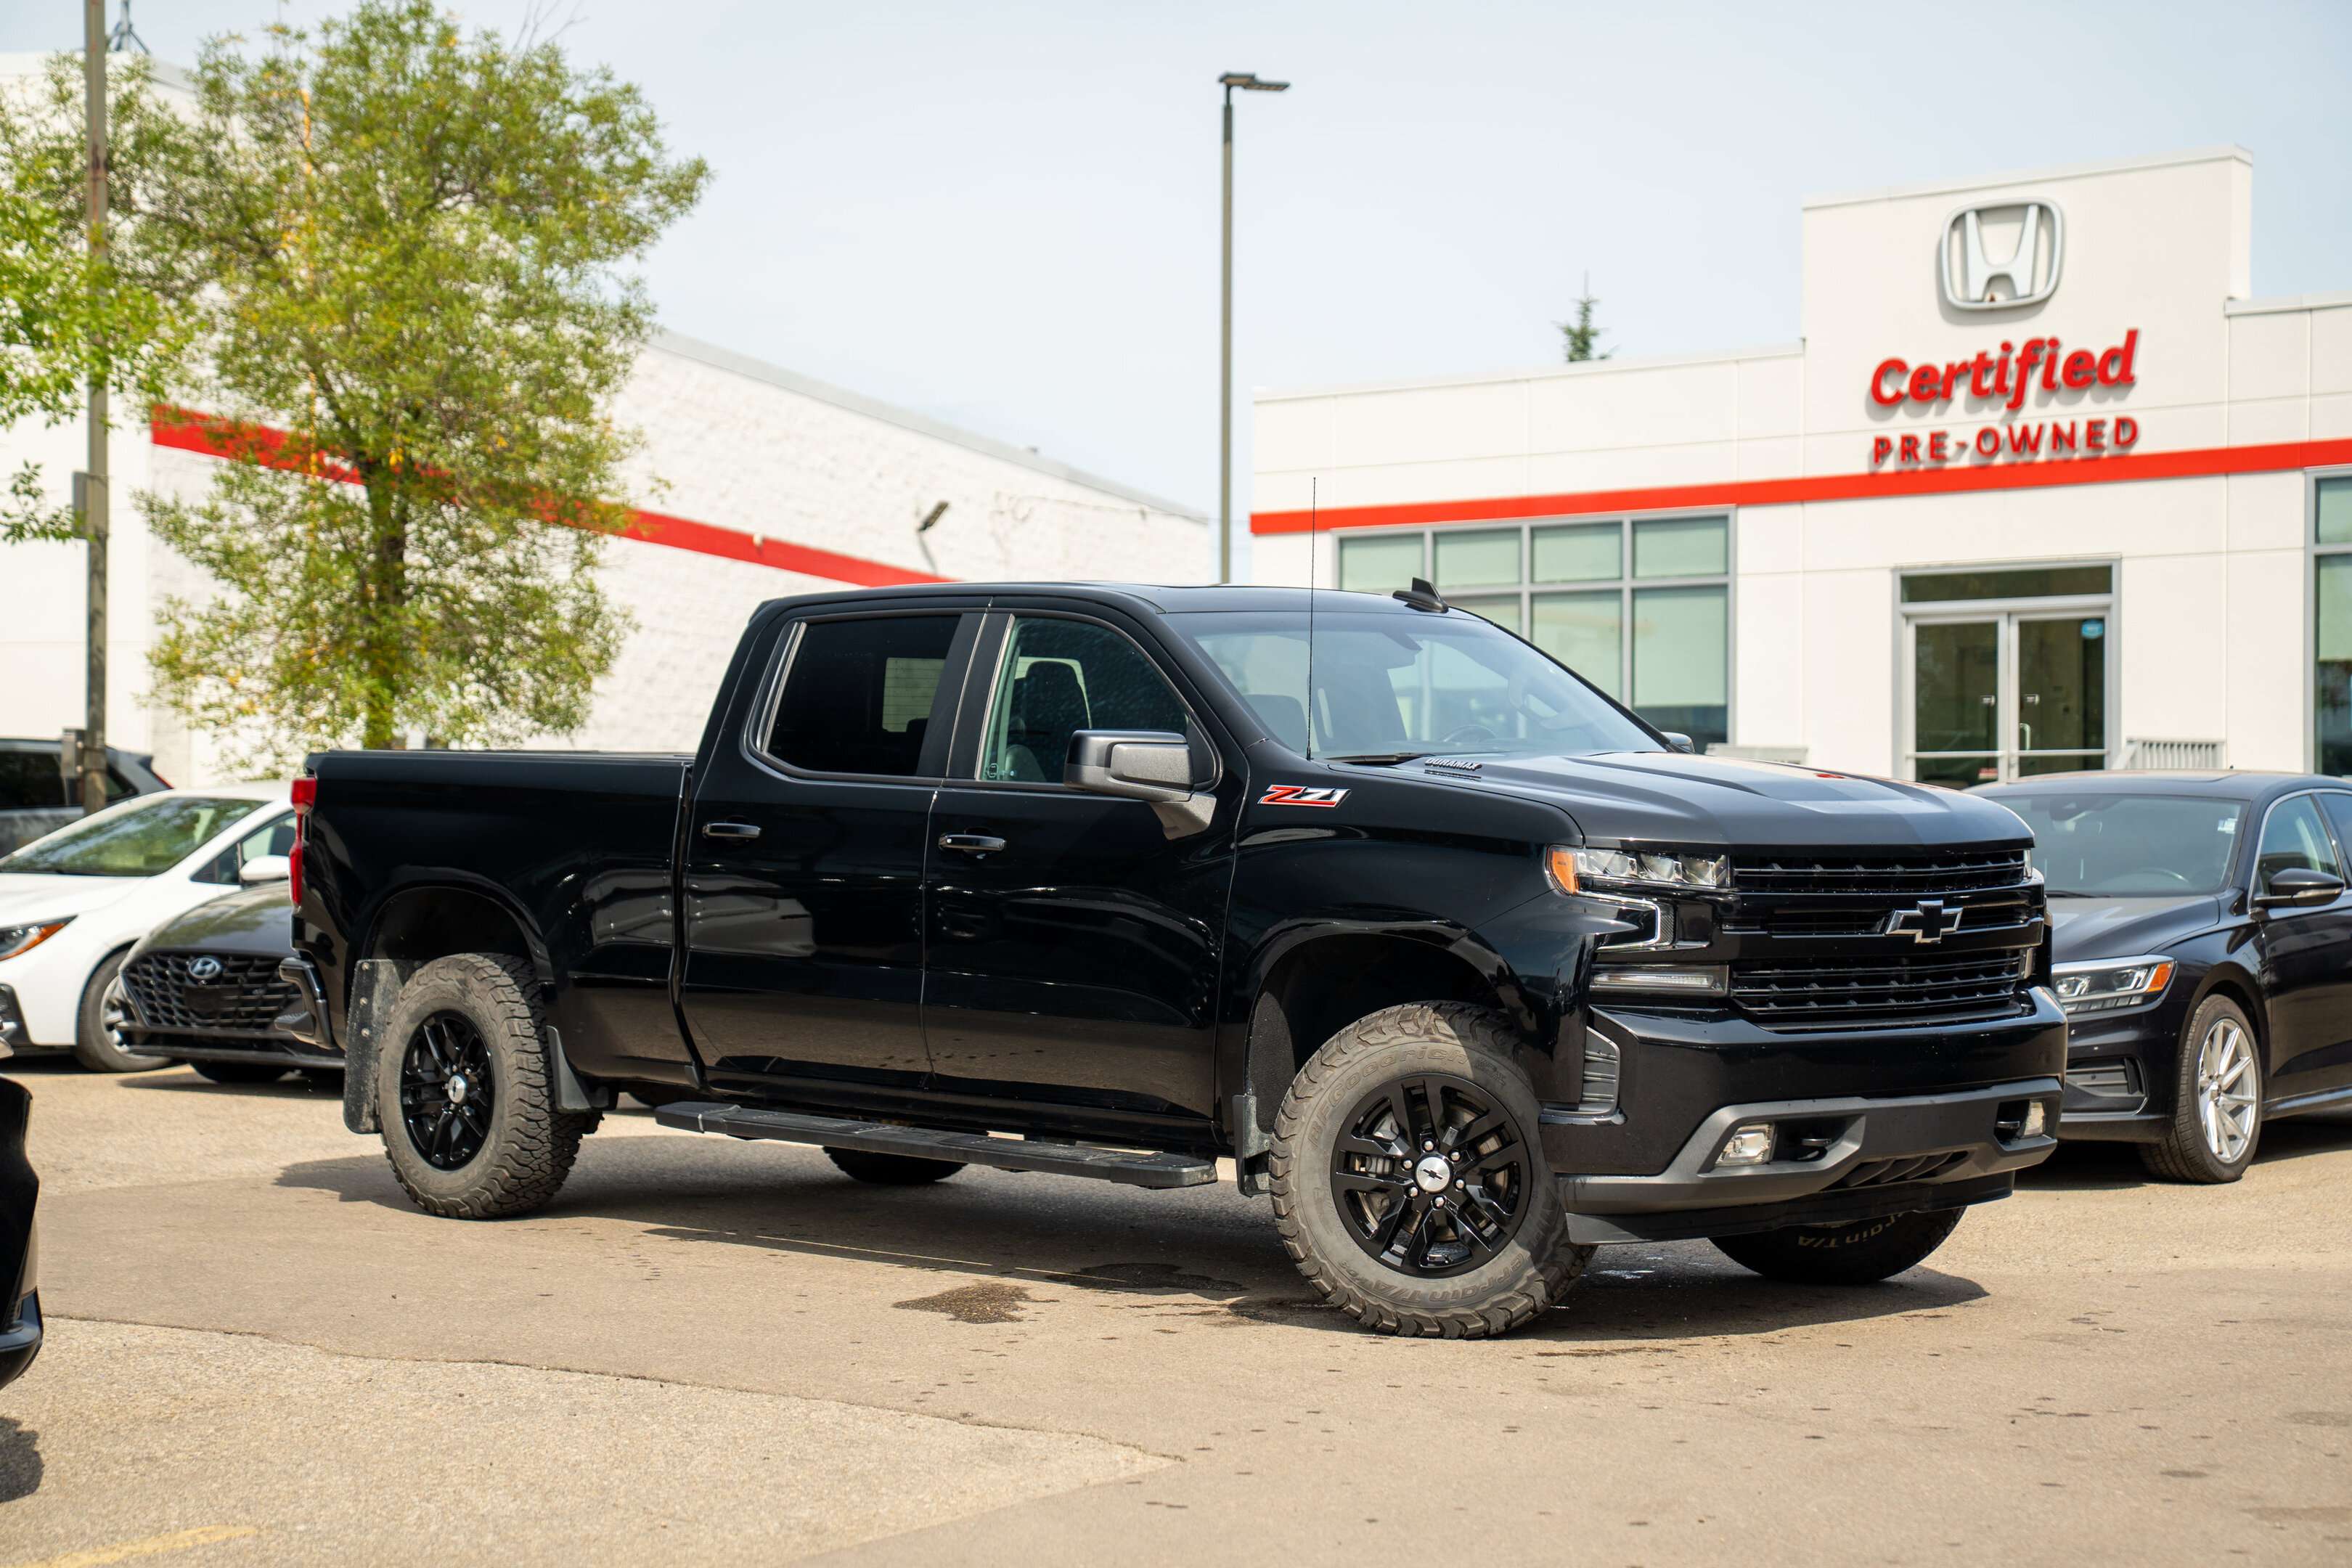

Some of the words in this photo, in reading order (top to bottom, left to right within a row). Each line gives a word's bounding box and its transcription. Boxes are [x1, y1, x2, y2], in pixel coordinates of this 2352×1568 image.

[1871, 328, 2139, 410] Certified
[1873, 416, 2139, 465] PRE-OWNED
[1424, 757, 1482, 772] DURAMAX
[1257, 784, 1351, 808] Z71
[1307, 1046, 1469, 1148] BFGoodrich
[1798, 1236, 1840, 1248] T/A
